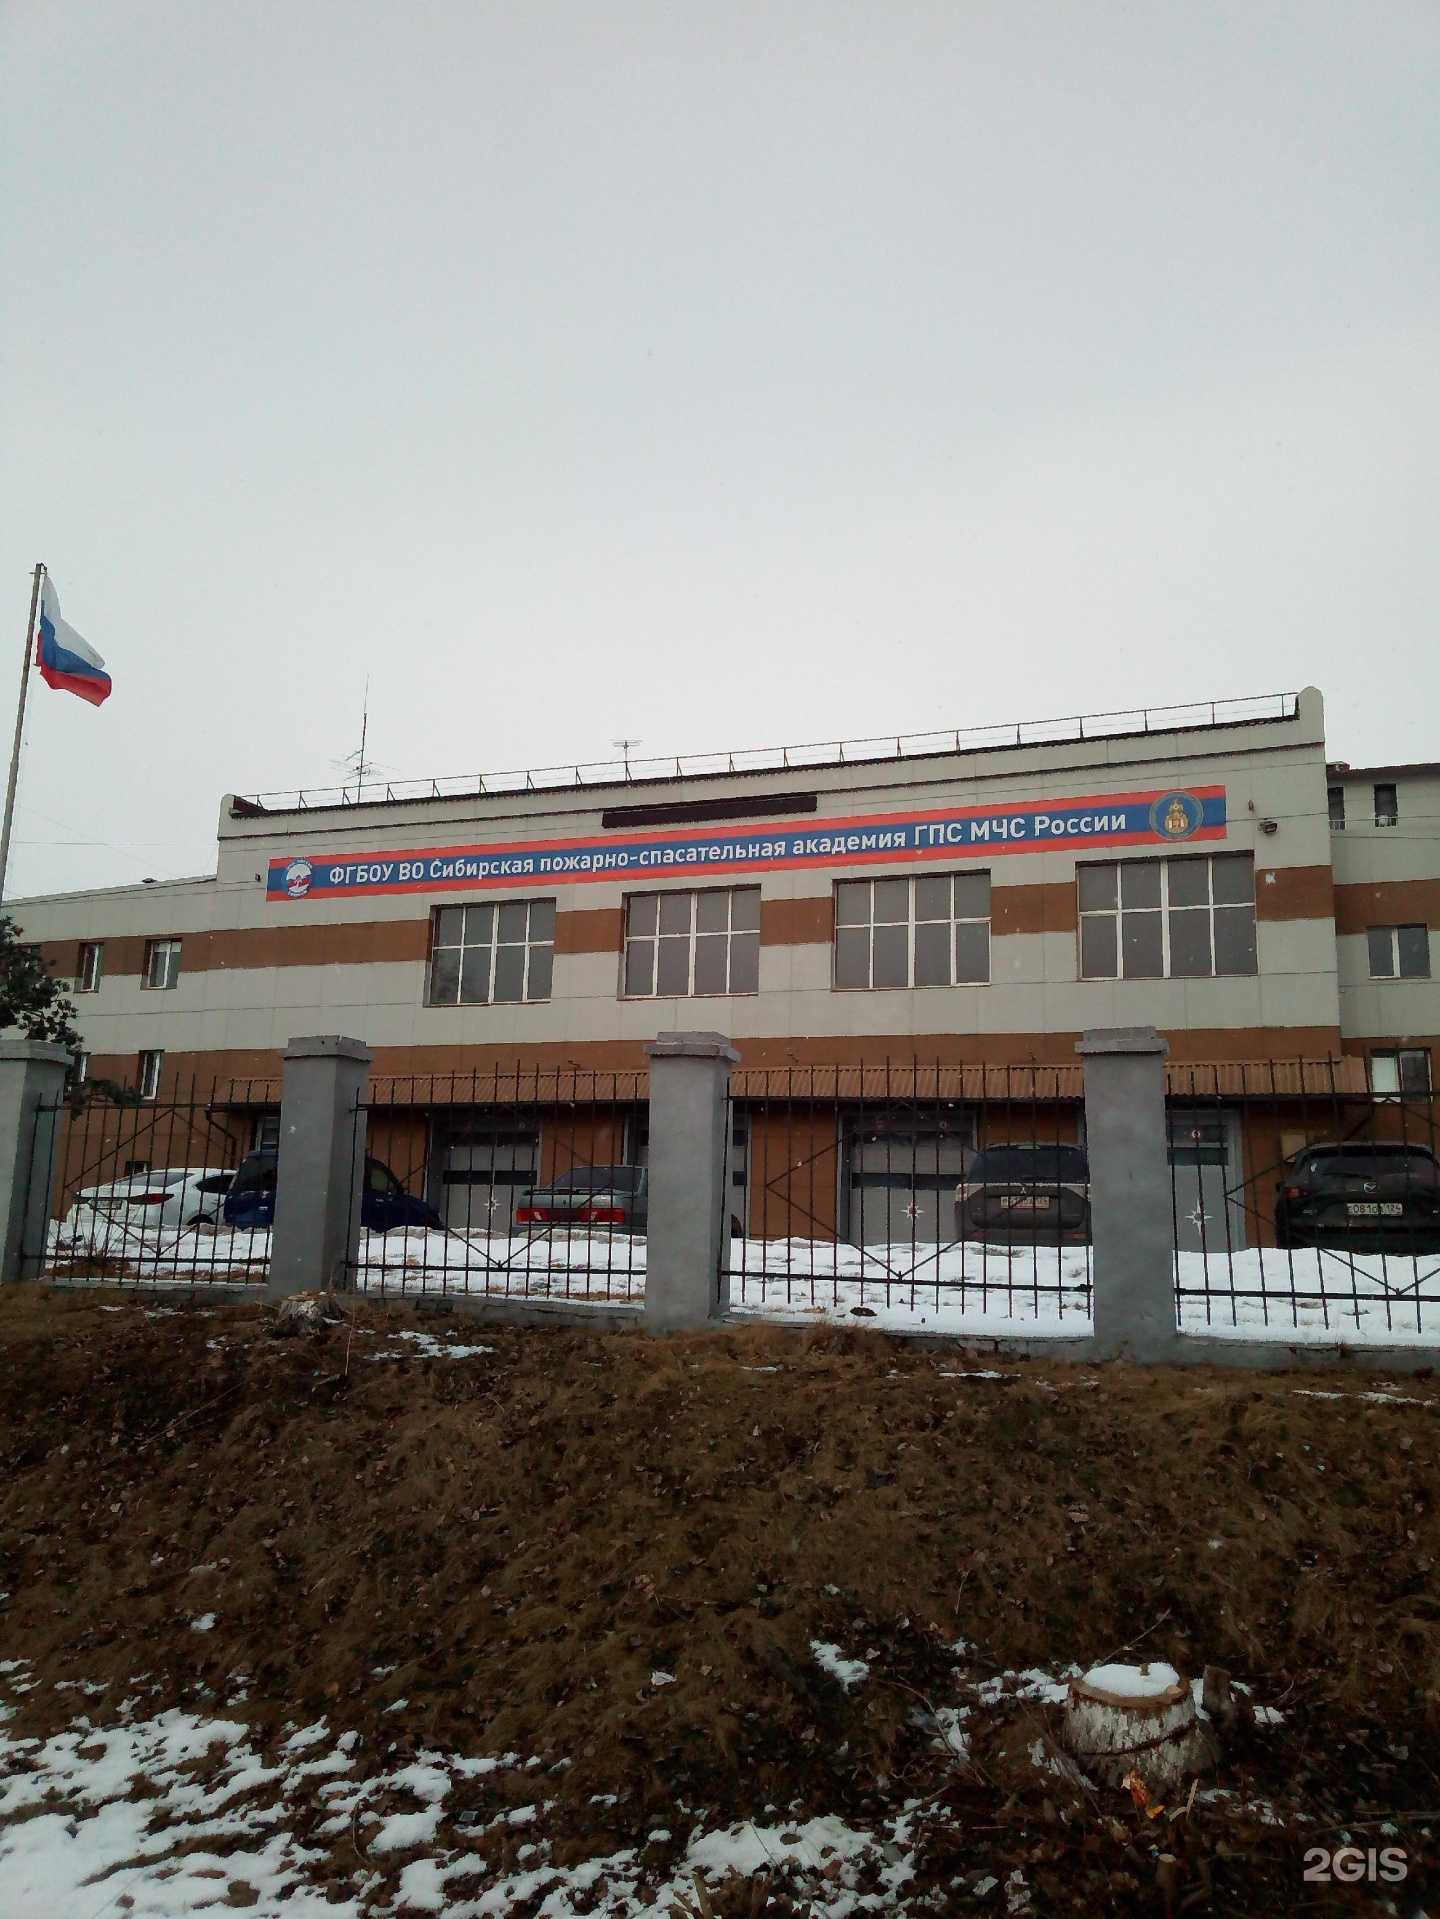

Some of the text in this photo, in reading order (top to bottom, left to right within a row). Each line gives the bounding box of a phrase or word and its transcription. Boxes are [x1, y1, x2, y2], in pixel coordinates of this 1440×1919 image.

[329, 814, 1126, 885] ФГБОУ ВО Сибирская пожарно-спасательная академия ГПС МЧС России
